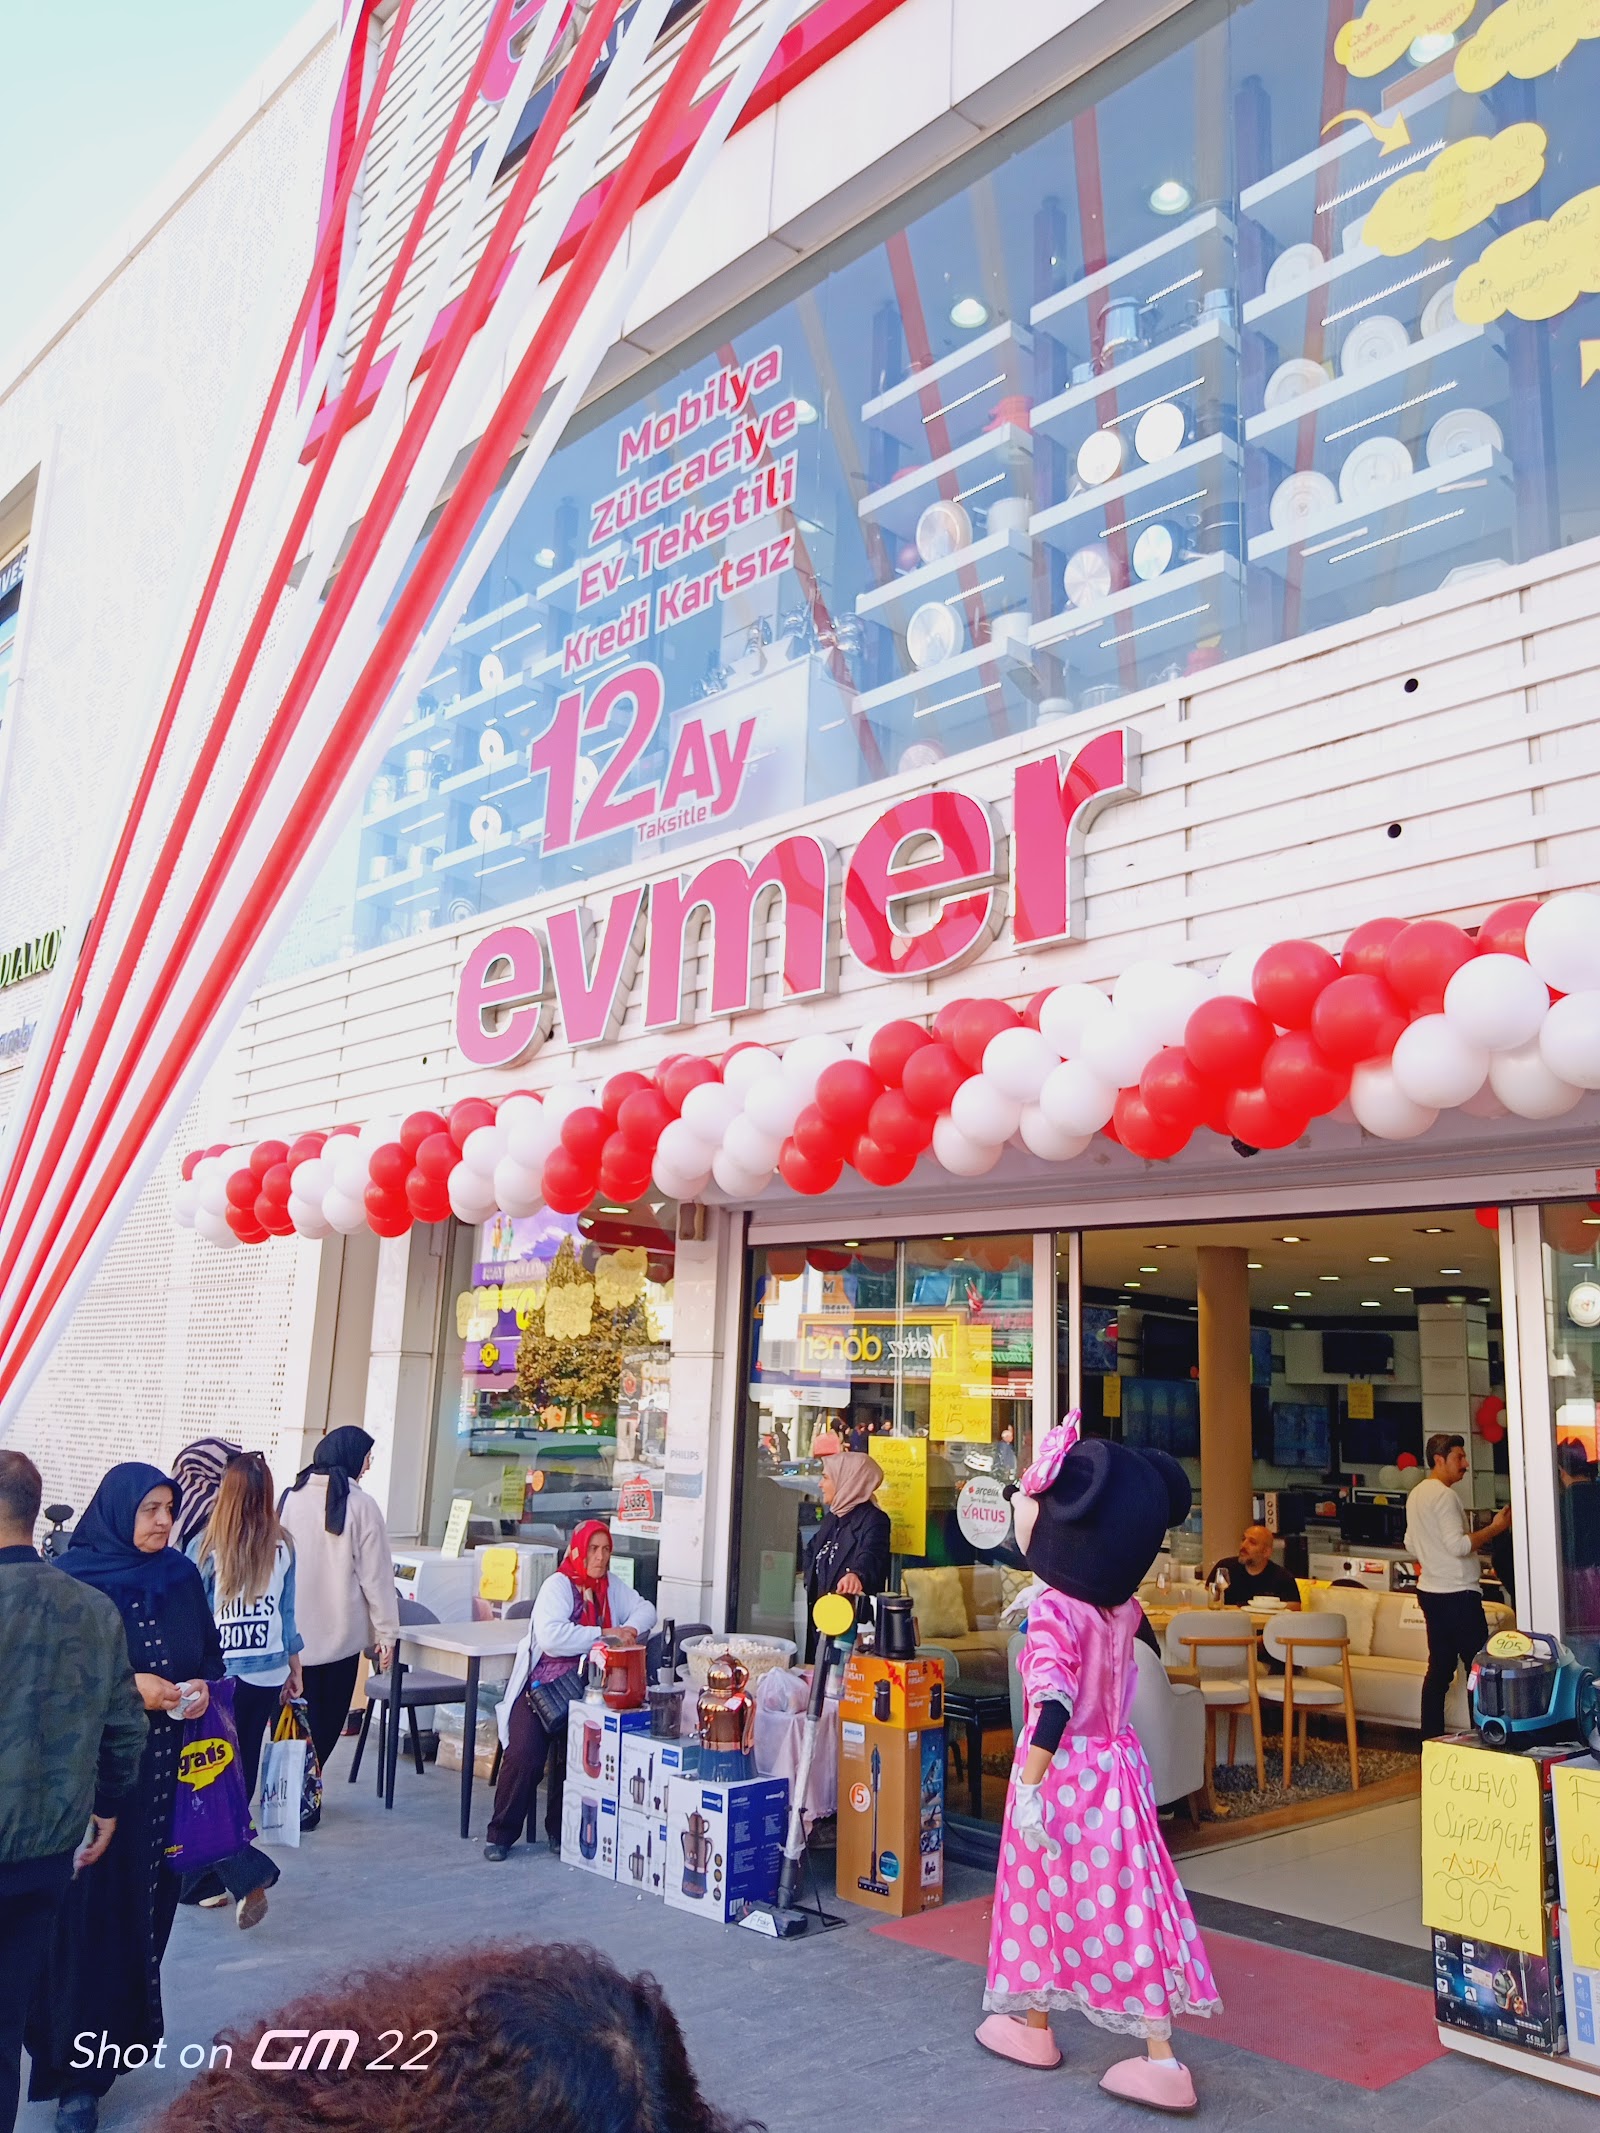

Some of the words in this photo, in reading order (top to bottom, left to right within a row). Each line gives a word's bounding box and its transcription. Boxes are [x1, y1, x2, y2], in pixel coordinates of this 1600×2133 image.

[619, 350, 779, 471] Mobilya
[591, 401, 796, 543] Züccaciye
[579, 558, 624, 606] Ev
[635, 457, 794, 574] Tekstili
[564, 601, 648, 673] Kredi
[659, 535, 791, 628] Kartsız
[530, 667, 662, 854] 12
[660, 717, 757, 816] Ay
[637, 806, 707, 842] Taksitle
[456, 728, 1140, 1069] evmer
[669, 1449, 700, 1461] PHILIPS
[971, 1507, 1006, 1523] ALTUS
[220, 1595, 275, 1620] RULES
[219, 1623, 267, 1650] BOYS
[1495, 1638, 1523, 1652] 905
[856, 1789, 864, 1804] 5
[1433, 1802, 1533, 1861] SÜPÜRGE
[1442, 1852, 1503, 1883] AYDA
[1440, 1878, 1512, 1938] 905
